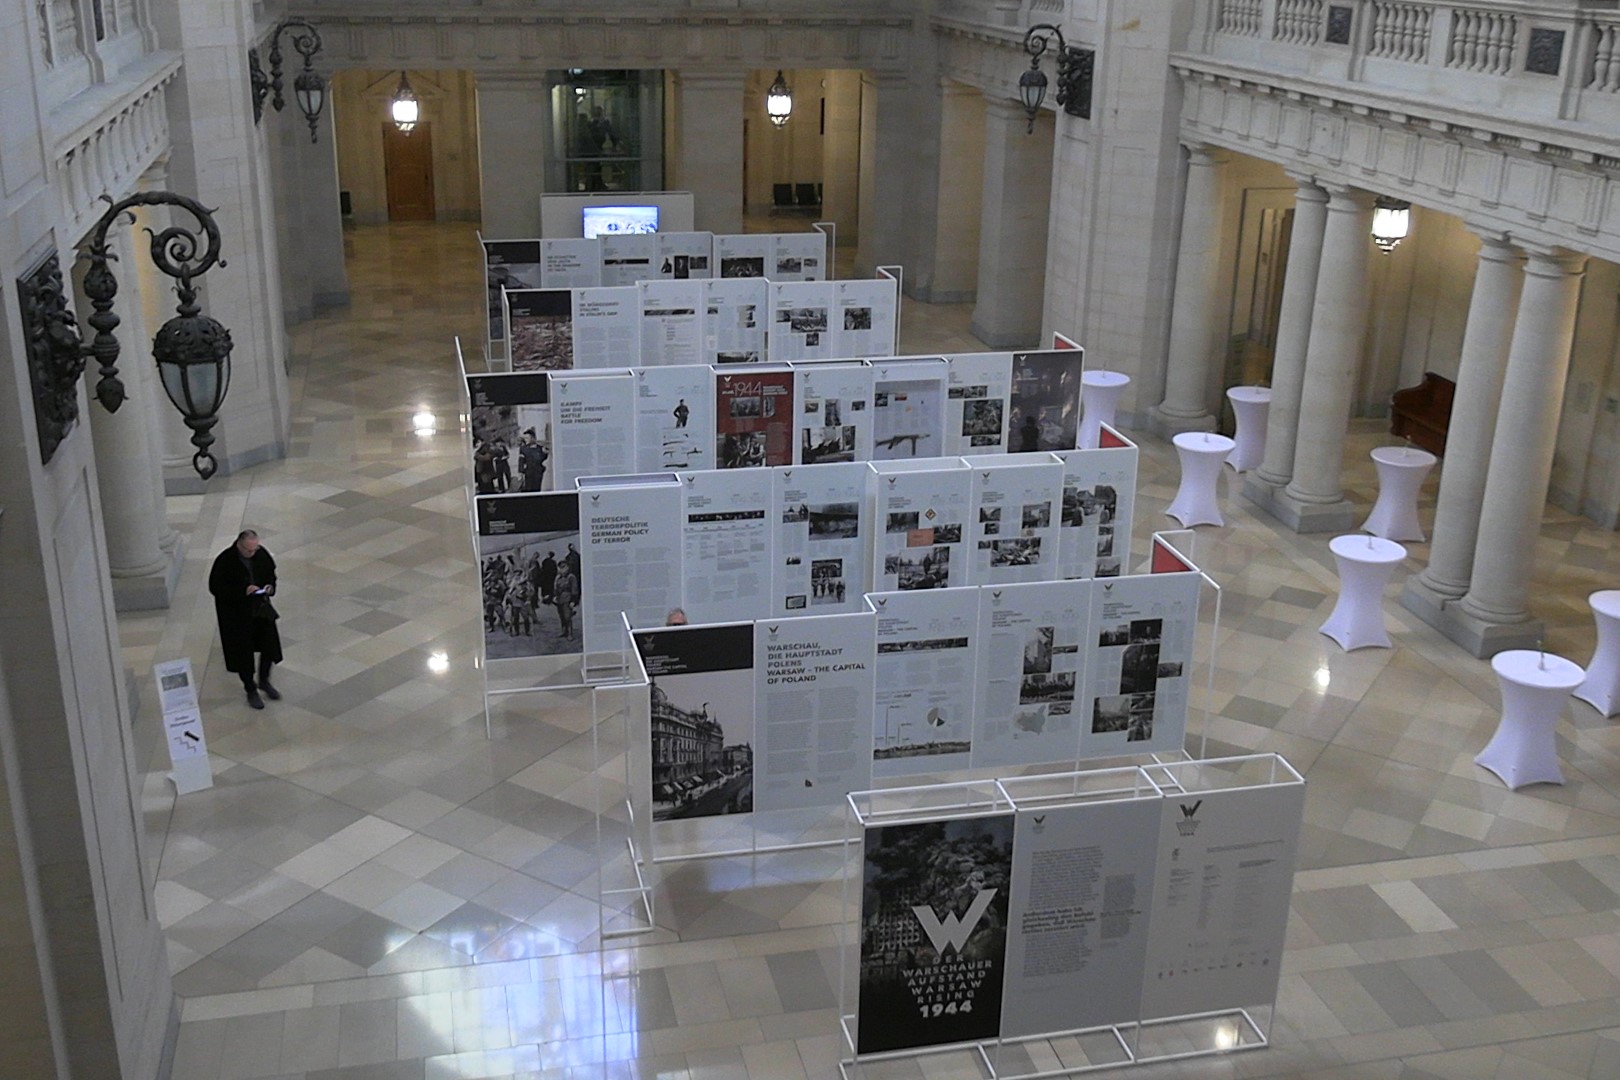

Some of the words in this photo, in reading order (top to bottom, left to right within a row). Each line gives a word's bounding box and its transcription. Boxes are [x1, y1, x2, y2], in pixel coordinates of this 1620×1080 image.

[733, 381, 761, 397] 1944
[591, 521, 649, 530] TERRORPOLITIK
[767, 642, 820, 652] WARSCHAU,
[768, 652, 783, 660] DIE
[785, 648, 843, 659] HAUPTSTADT
[767, 668, 806, 676] WARSAW
[832, 663, 865, 671] CAPITAL
[768, 660, 802, 668] POLENS
[767, 677, 780, 685] OF
[781, 675, 817, 684] POLAND
[911, 887, 998, 958] W
[932, 954, 964, 965] DER
[902, 960, 992, 978] WARSCHAUER
[907, 970, 986, 987] AUFSTAND
[911, 980, 981, 996] WARSAW
[917, 989, 975, 1004] RISING
[920, 1000, 972, 1018] 1944
